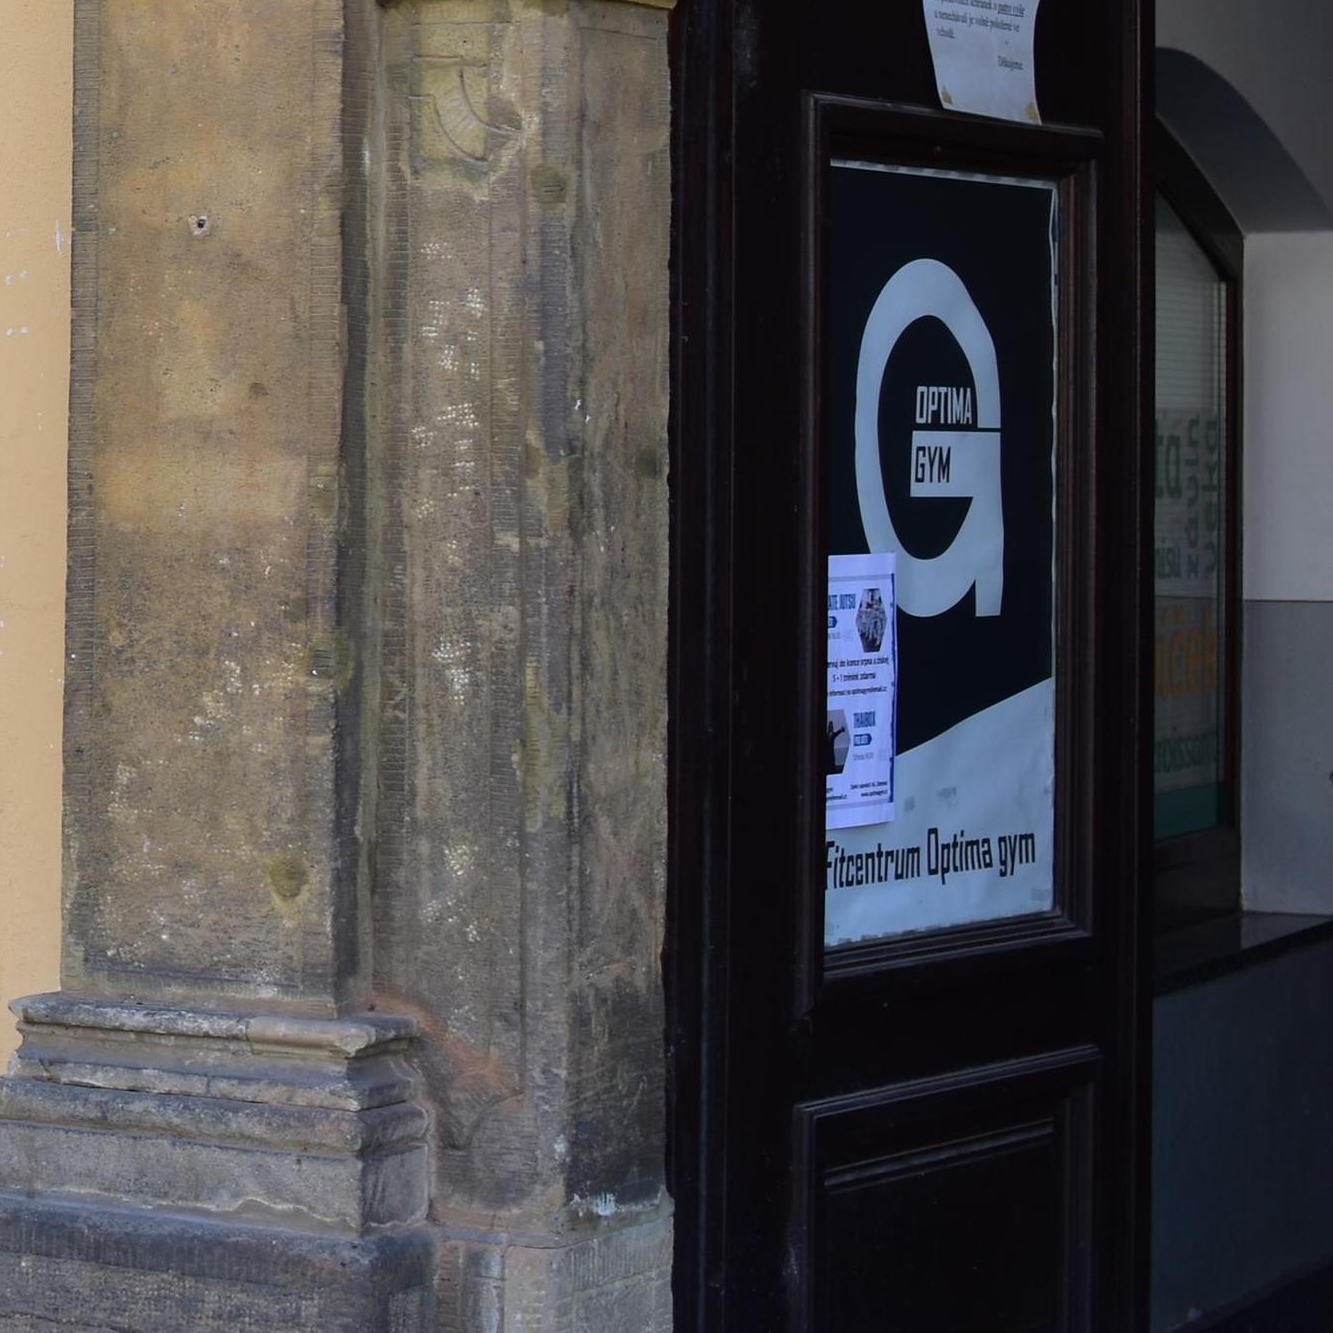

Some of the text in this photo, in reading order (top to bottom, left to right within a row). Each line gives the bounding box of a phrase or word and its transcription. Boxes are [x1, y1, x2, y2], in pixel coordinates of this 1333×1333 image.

[915, 385, 973, 426] OPTIMA
[913, 445, 952, 484] GYM
[926, 826, 993, 886] Optima
[997, 832, 1036, 878] gym
